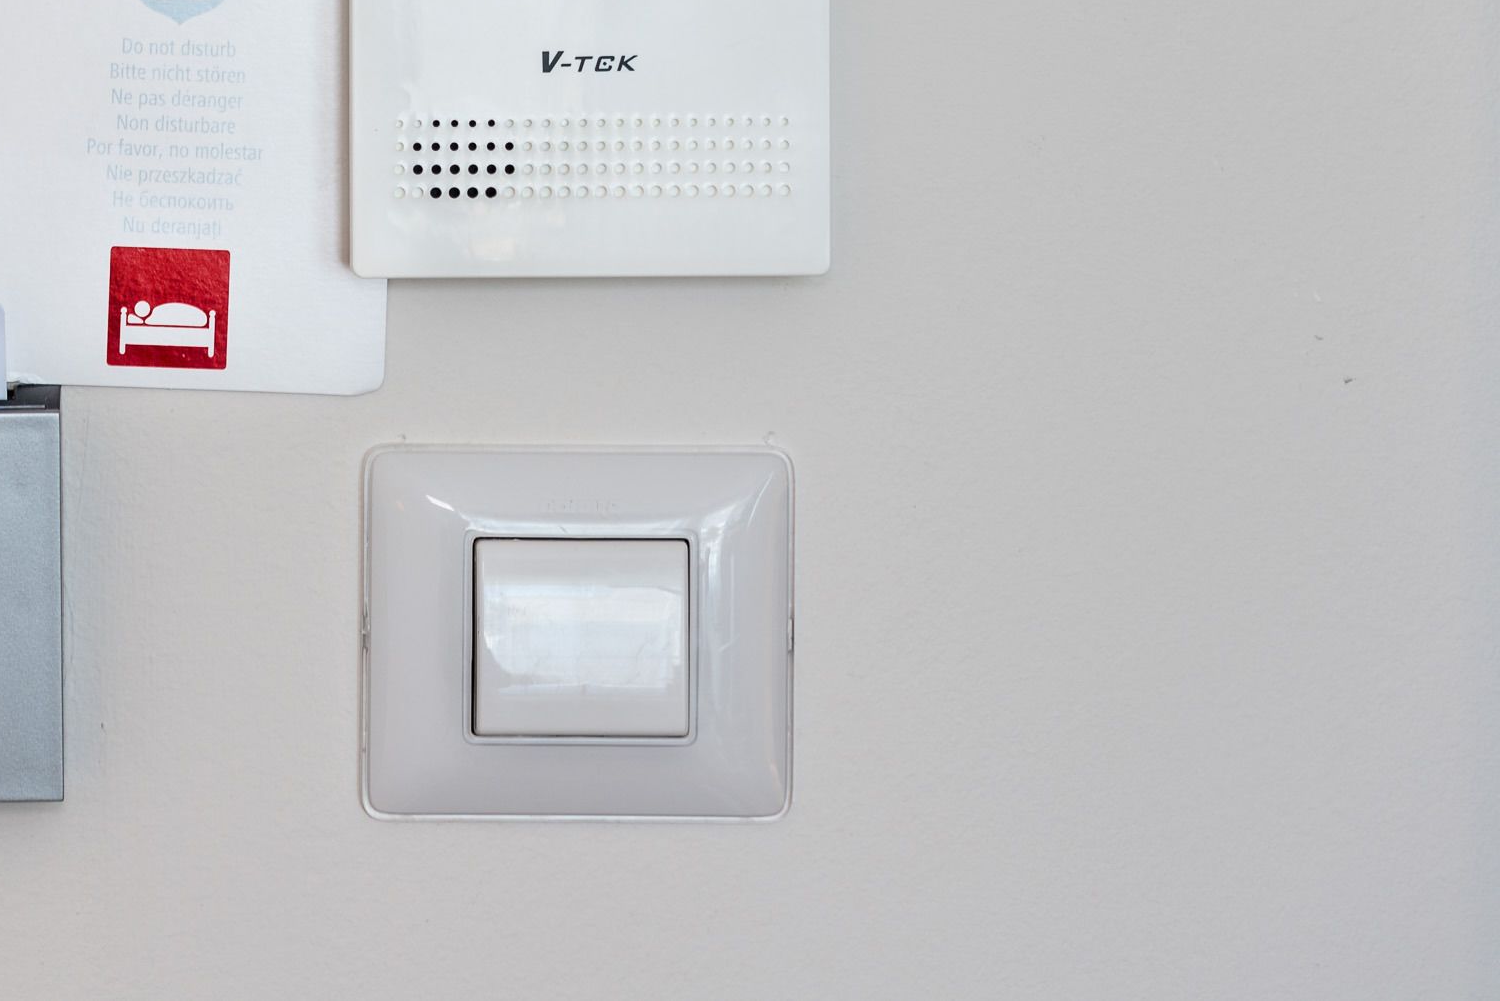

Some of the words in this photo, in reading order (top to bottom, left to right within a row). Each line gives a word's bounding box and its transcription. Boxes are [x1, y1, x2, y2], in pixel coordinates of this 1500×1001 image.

[121, 37, 144, 55] Do
[149, 40, 175, 56] not
[181, 40, 237, 57] disturb
[110, 62, 146, 80] Bitte
[152, 63, 192, 82] nicht
[197, 66, 247, 84] stören
[111, 88, 133, 105] Ne
[138, 91, 166, 110] pas
[171, 89, 244, 113] déranger
[116, 114, 149, 131] Non
[155, 115, 236, 134] disturbare
[86, 138, 112, 155] Por
[119, 138, 163, 160] favor,
[169, 142, 189, 158] no
[195, 143, 264, 161] molestar
[106, 164, 133, 181] Nie
[138, 167, 244, 186] przeszkadzać
[139, 191, 235, 211] беспокоить
[123, 216, 145, 233] Nu
